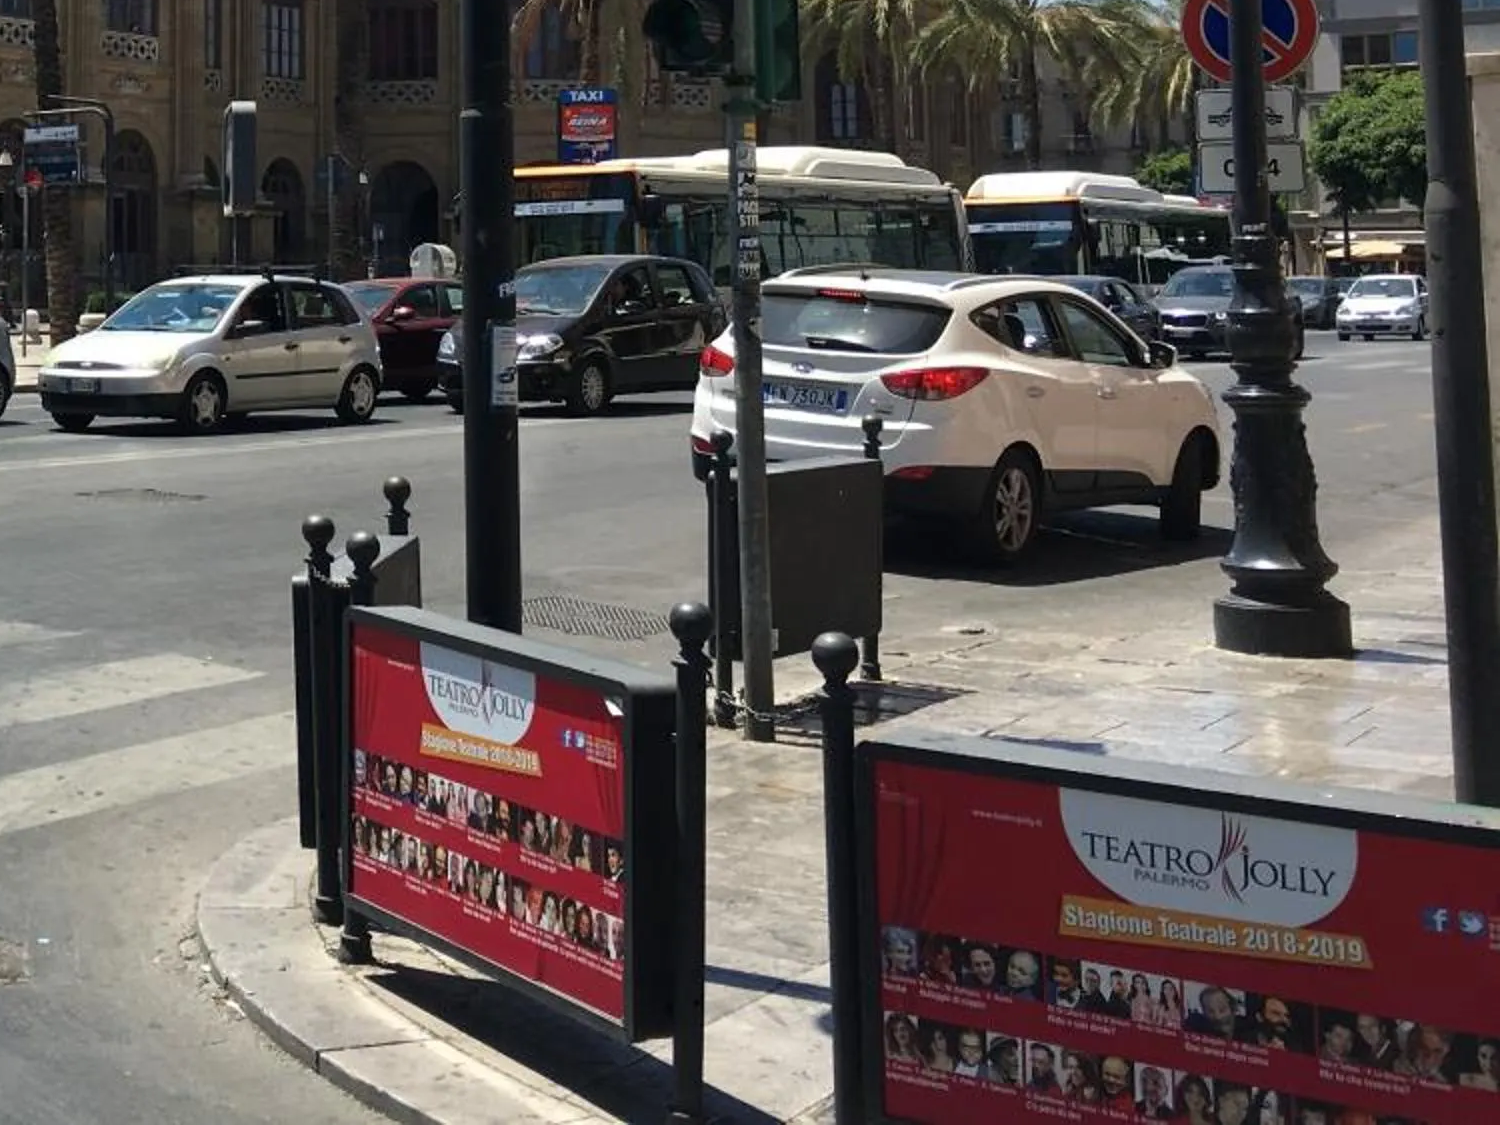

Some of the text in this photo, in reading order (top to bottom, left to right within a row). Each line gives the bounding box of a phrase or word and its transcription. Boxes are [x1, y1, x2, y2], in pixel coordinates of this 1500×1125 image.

[568, 90, 604, 102] TAXI
[430, 675, 480, 707] TEATRO
[1081, 830, 1337, 898] TEATRO JOLLY
[1133, 866, 1211, 892] PALERMO
[1063, 902, 1365, 964] Stagione Teatrale 2018-2019
